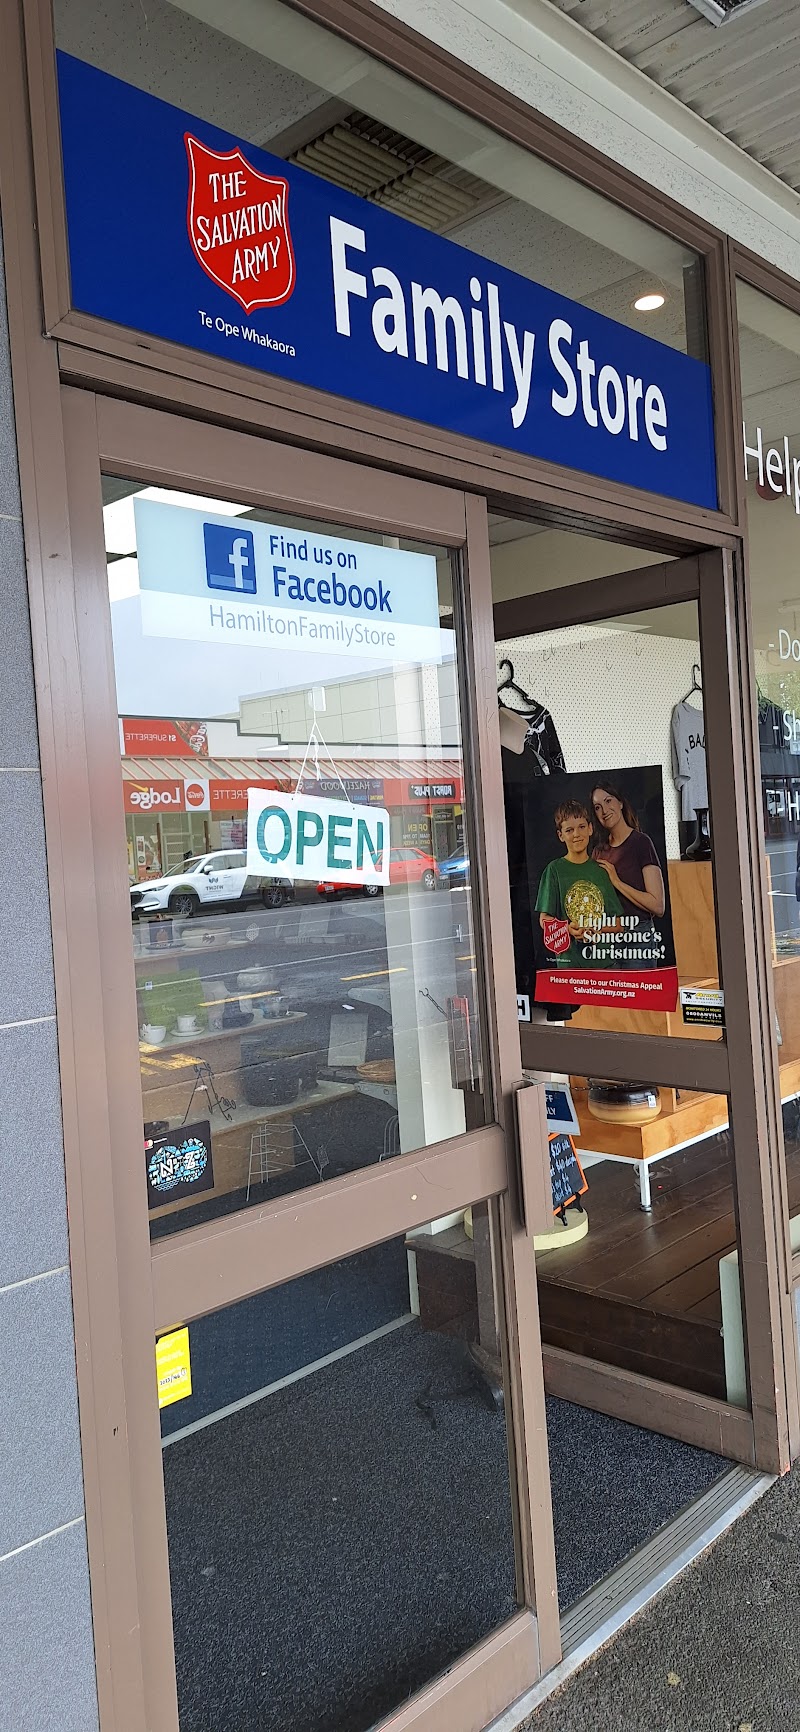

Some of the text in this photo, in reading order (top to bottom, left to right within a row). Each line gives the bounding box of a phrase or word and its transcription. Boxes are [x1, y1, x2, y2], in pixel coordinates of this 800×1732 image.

[208, 170, 246, 202] THE
[196, 194, 283, 251] SALVATION
[232, 236, 280, 284] ARMY
[198, 310, 296, 357] Te Ope Whakaora
[330, 215, 668, 450] Family Store
[270, 534, 357, 570] Find us on
[272, 565, 392, 613] Facebook
[210, 604, 396, 647] HamiltonFamilyStore
[256, 805, 384, 872] OPEN
[579, 912, 639, 930] Light up
[583, 928, 662, 943] Someone's
[582, 944, 665, 959] Christmas!
[569, 977, 589, 985] donate
[609, 980, 639, 988] Christmas
[640, 982, 663, 990] Appeal
[574, 987, 636, 998] SalvationArmy.org.nz
